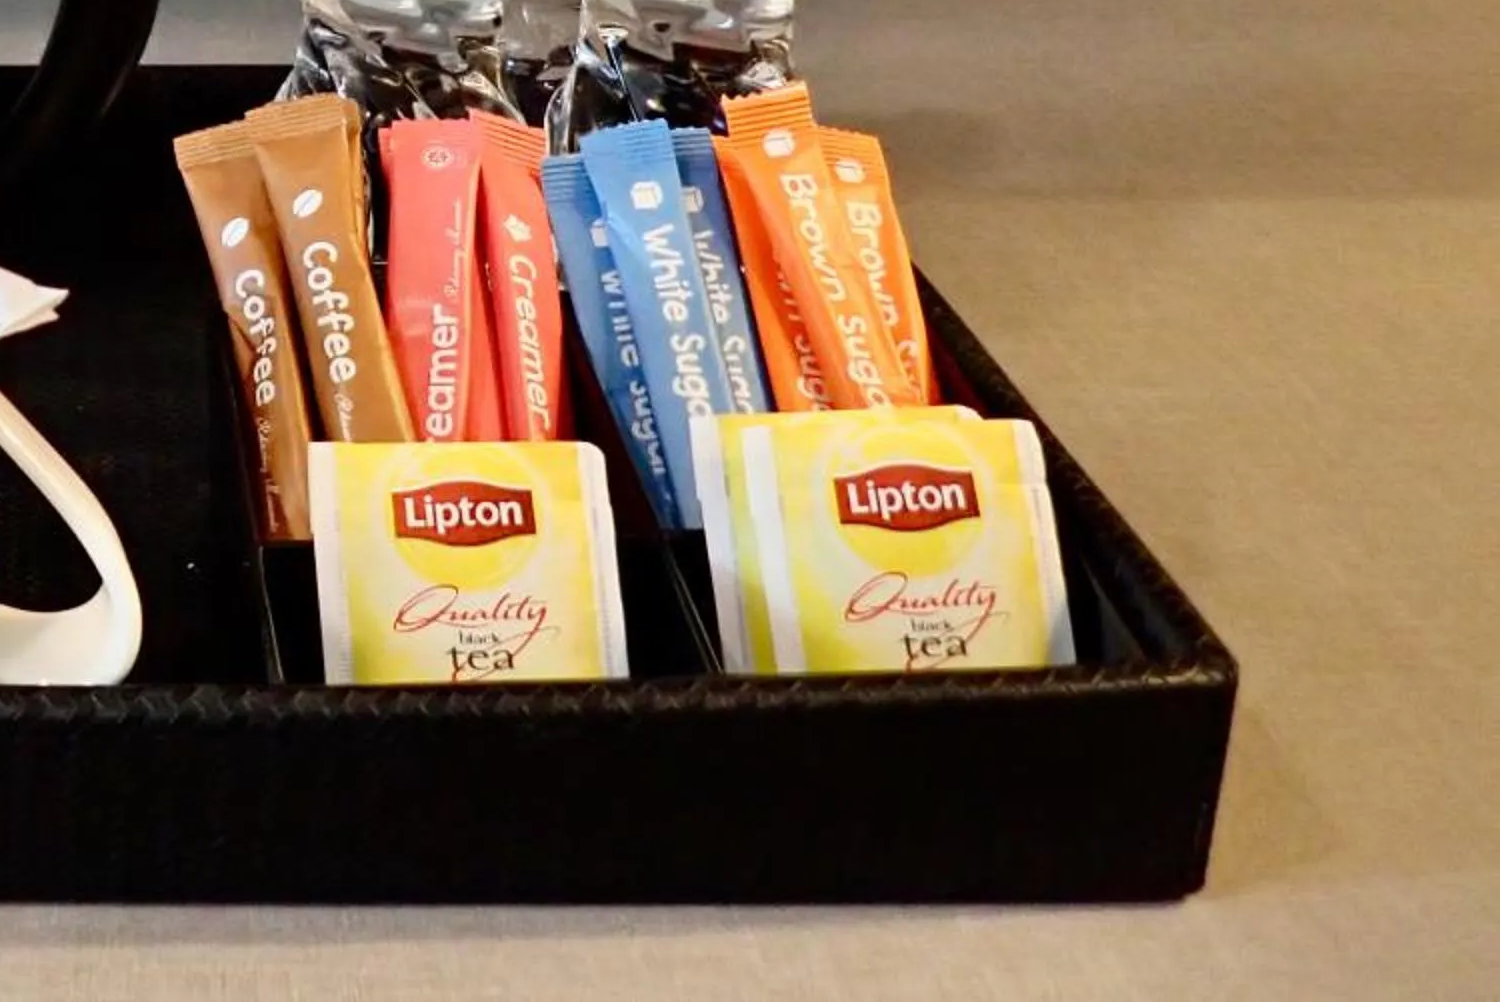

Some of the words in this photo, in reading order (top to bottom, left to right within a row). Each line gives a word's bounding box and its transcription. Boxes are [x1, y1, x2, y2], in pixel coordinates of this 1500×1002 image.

[779, 173, 846, 305] Brown
[837, 314, 892, 411] Suga
[847, 201, 899, 328] Brown
[235, 268, 277, 407] Coffee
[303, 241, 357, 384] Coffee
[509, 254, 550, 430] Creamer
[642, 223, 695, 323] White
[671, 334, 714, 416] Suga
[425, 302, 459, 441] eamer
[403, 494, 524, 535] Lipton
[847, 479, 966, 521] Lipton
[393, 584, 555, 643] Quality
[845, 571, 1003, 631] Quality
[910, 618, 955, 633] black
[446, 646, 516, 671] tea
[458, 629, 501, 645] black
[900, 635, 968, 658] tea
